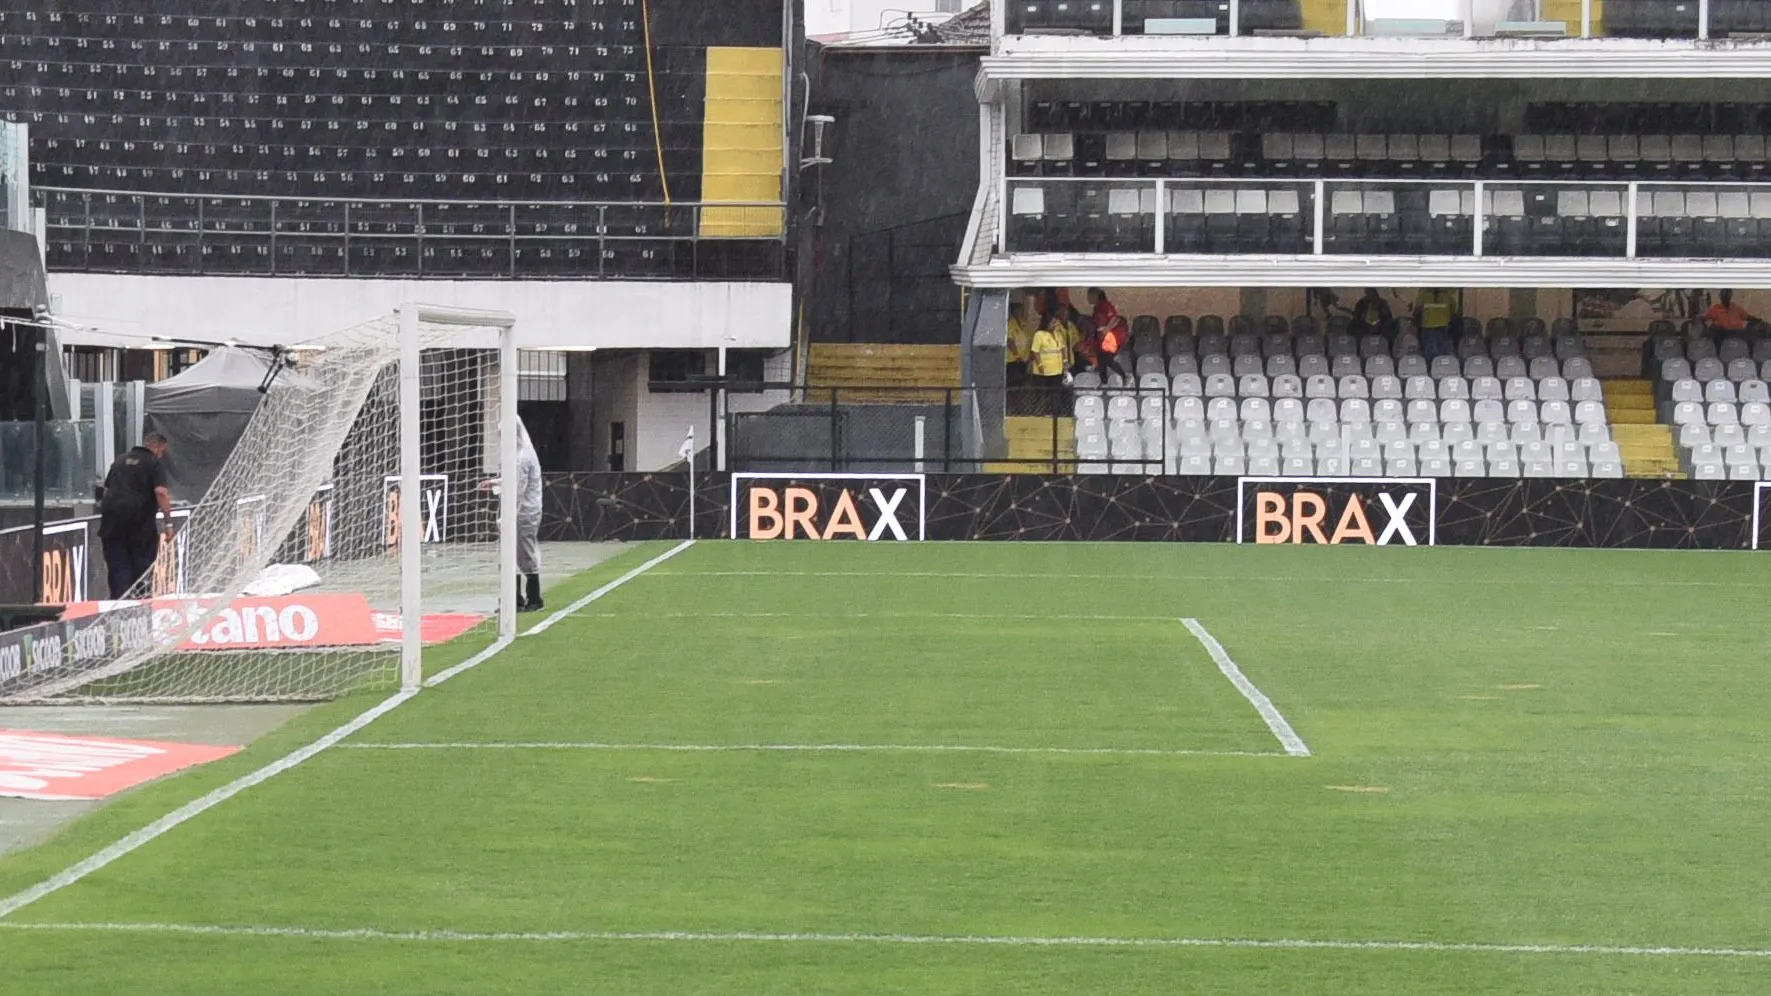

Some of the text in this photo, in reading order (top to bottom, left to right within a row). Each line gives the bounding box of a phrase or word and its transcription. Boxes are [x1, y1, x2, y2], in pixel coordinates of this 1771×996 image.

[388, 490, 441, 544] BX
[749, 487, 908, 541] BRAX
[1256, 492, 1418, 546] BRAX
[43, 545, 84, 603] BRAX
